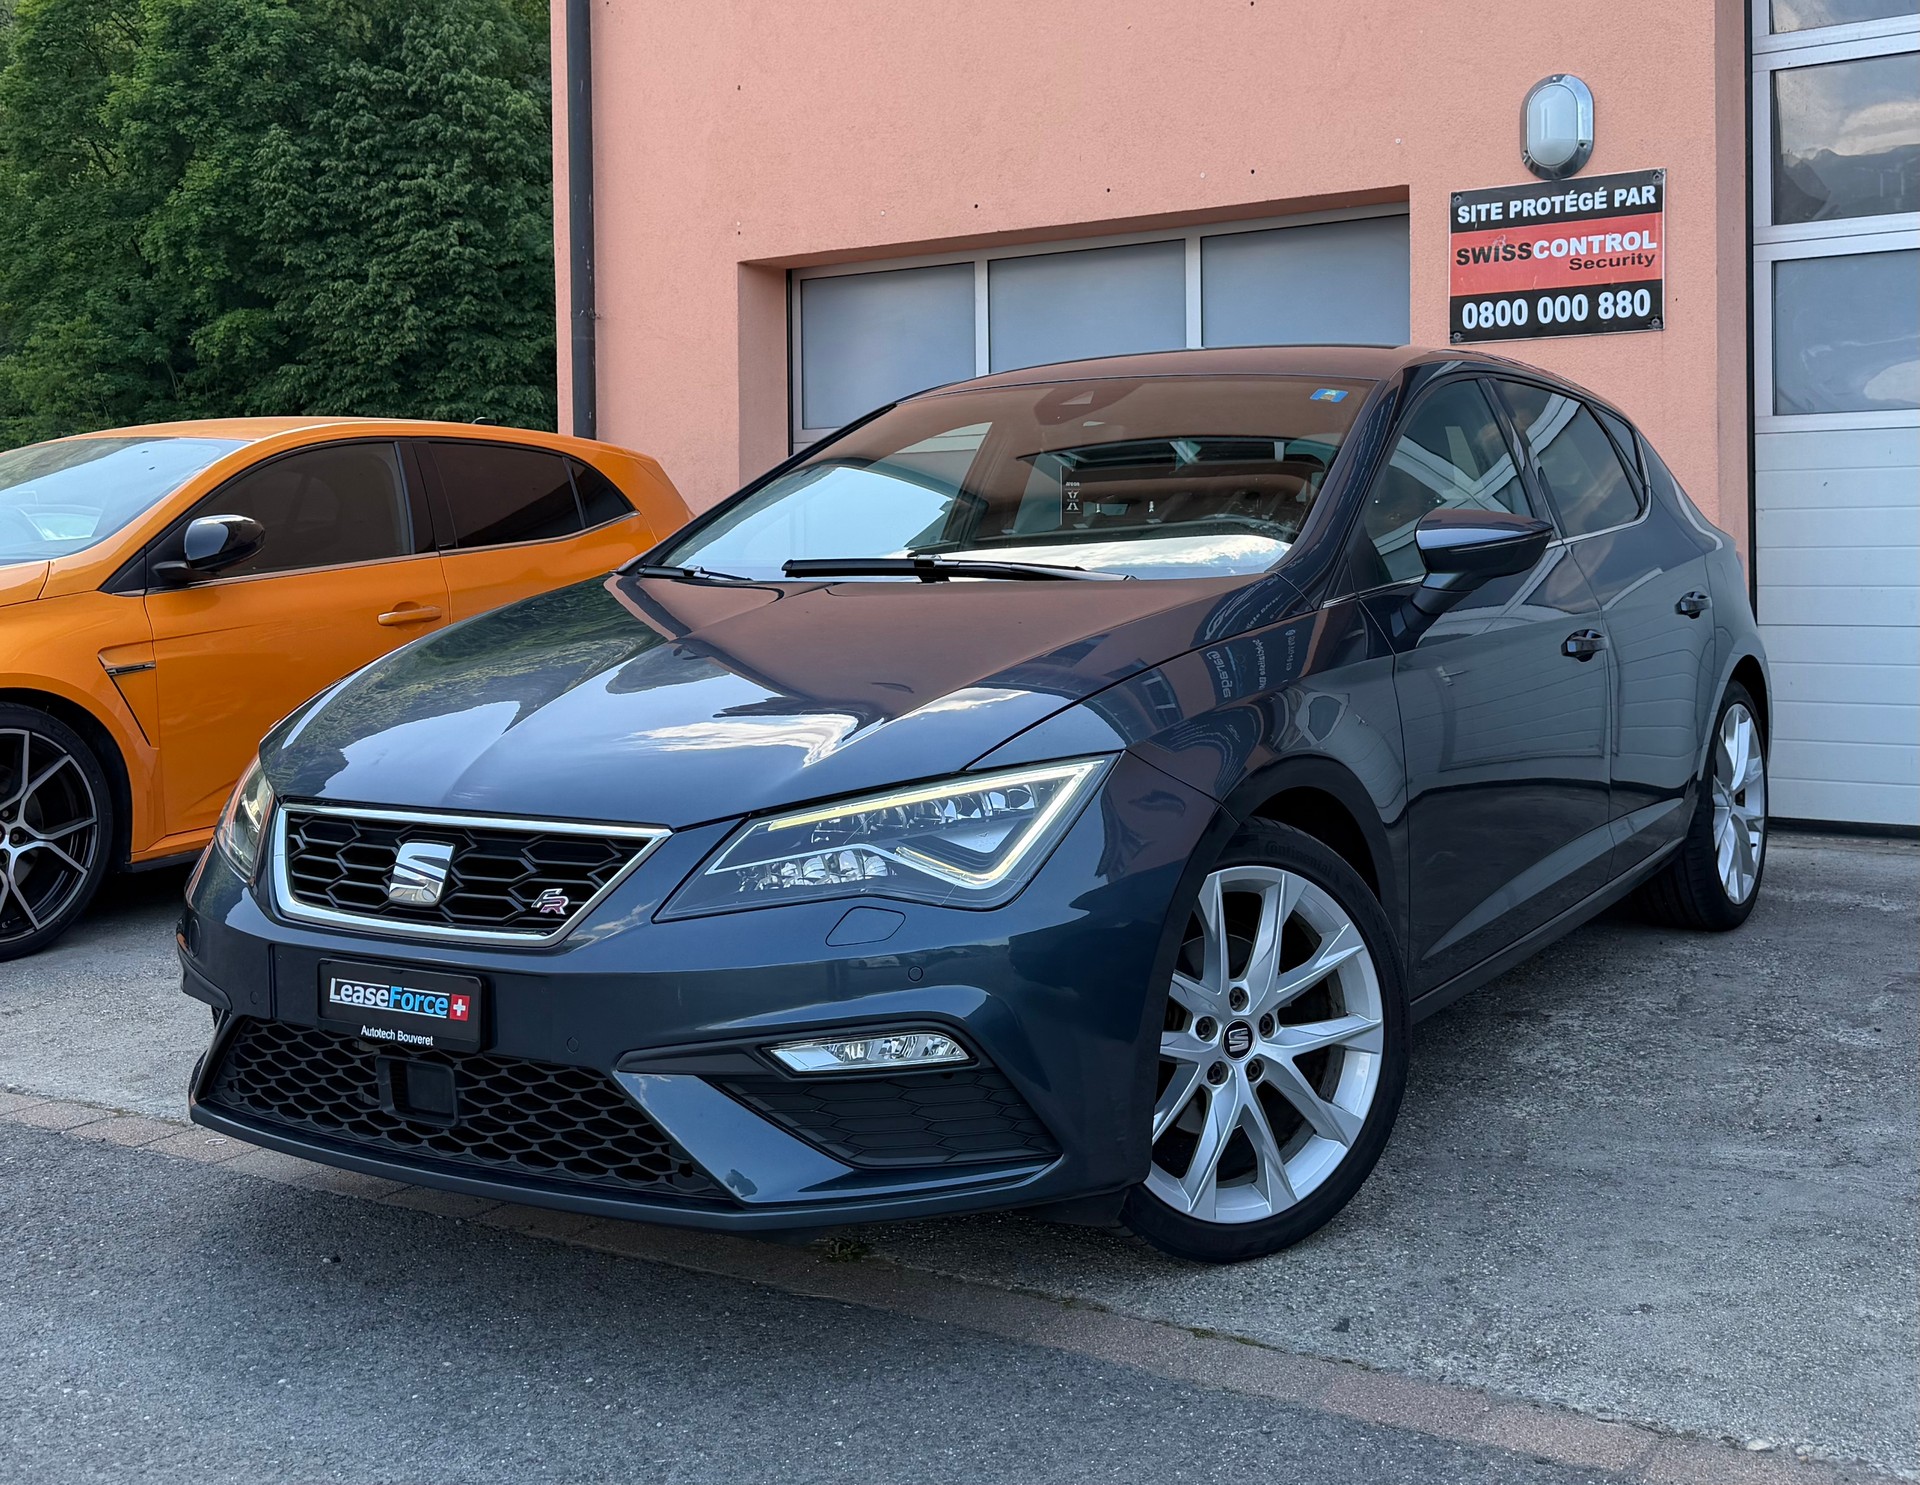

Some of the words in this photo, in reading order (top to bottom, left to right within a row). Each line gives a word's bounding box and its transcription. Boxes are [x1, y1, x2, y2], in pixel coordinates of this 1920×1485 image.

[1457, 202, 1503, 224] SITE
[1509, 186, 1607, 219] PROTÉGÉ
[1614, 185, 1656, 207] PAR
[1568, 253, 1656, 271] Security
[1462, 298, 1528, 329] 0800
[1537, 294, 1588, 324] 000
[1598, 289, 1651, 320] 880
[531, 888, 569, 915] FR
[329, 977, 449, 1016] LeaseForce
[360, 1025, 395, 1041] Autotech
[397, 1030, 433, 1046] Bouveret
